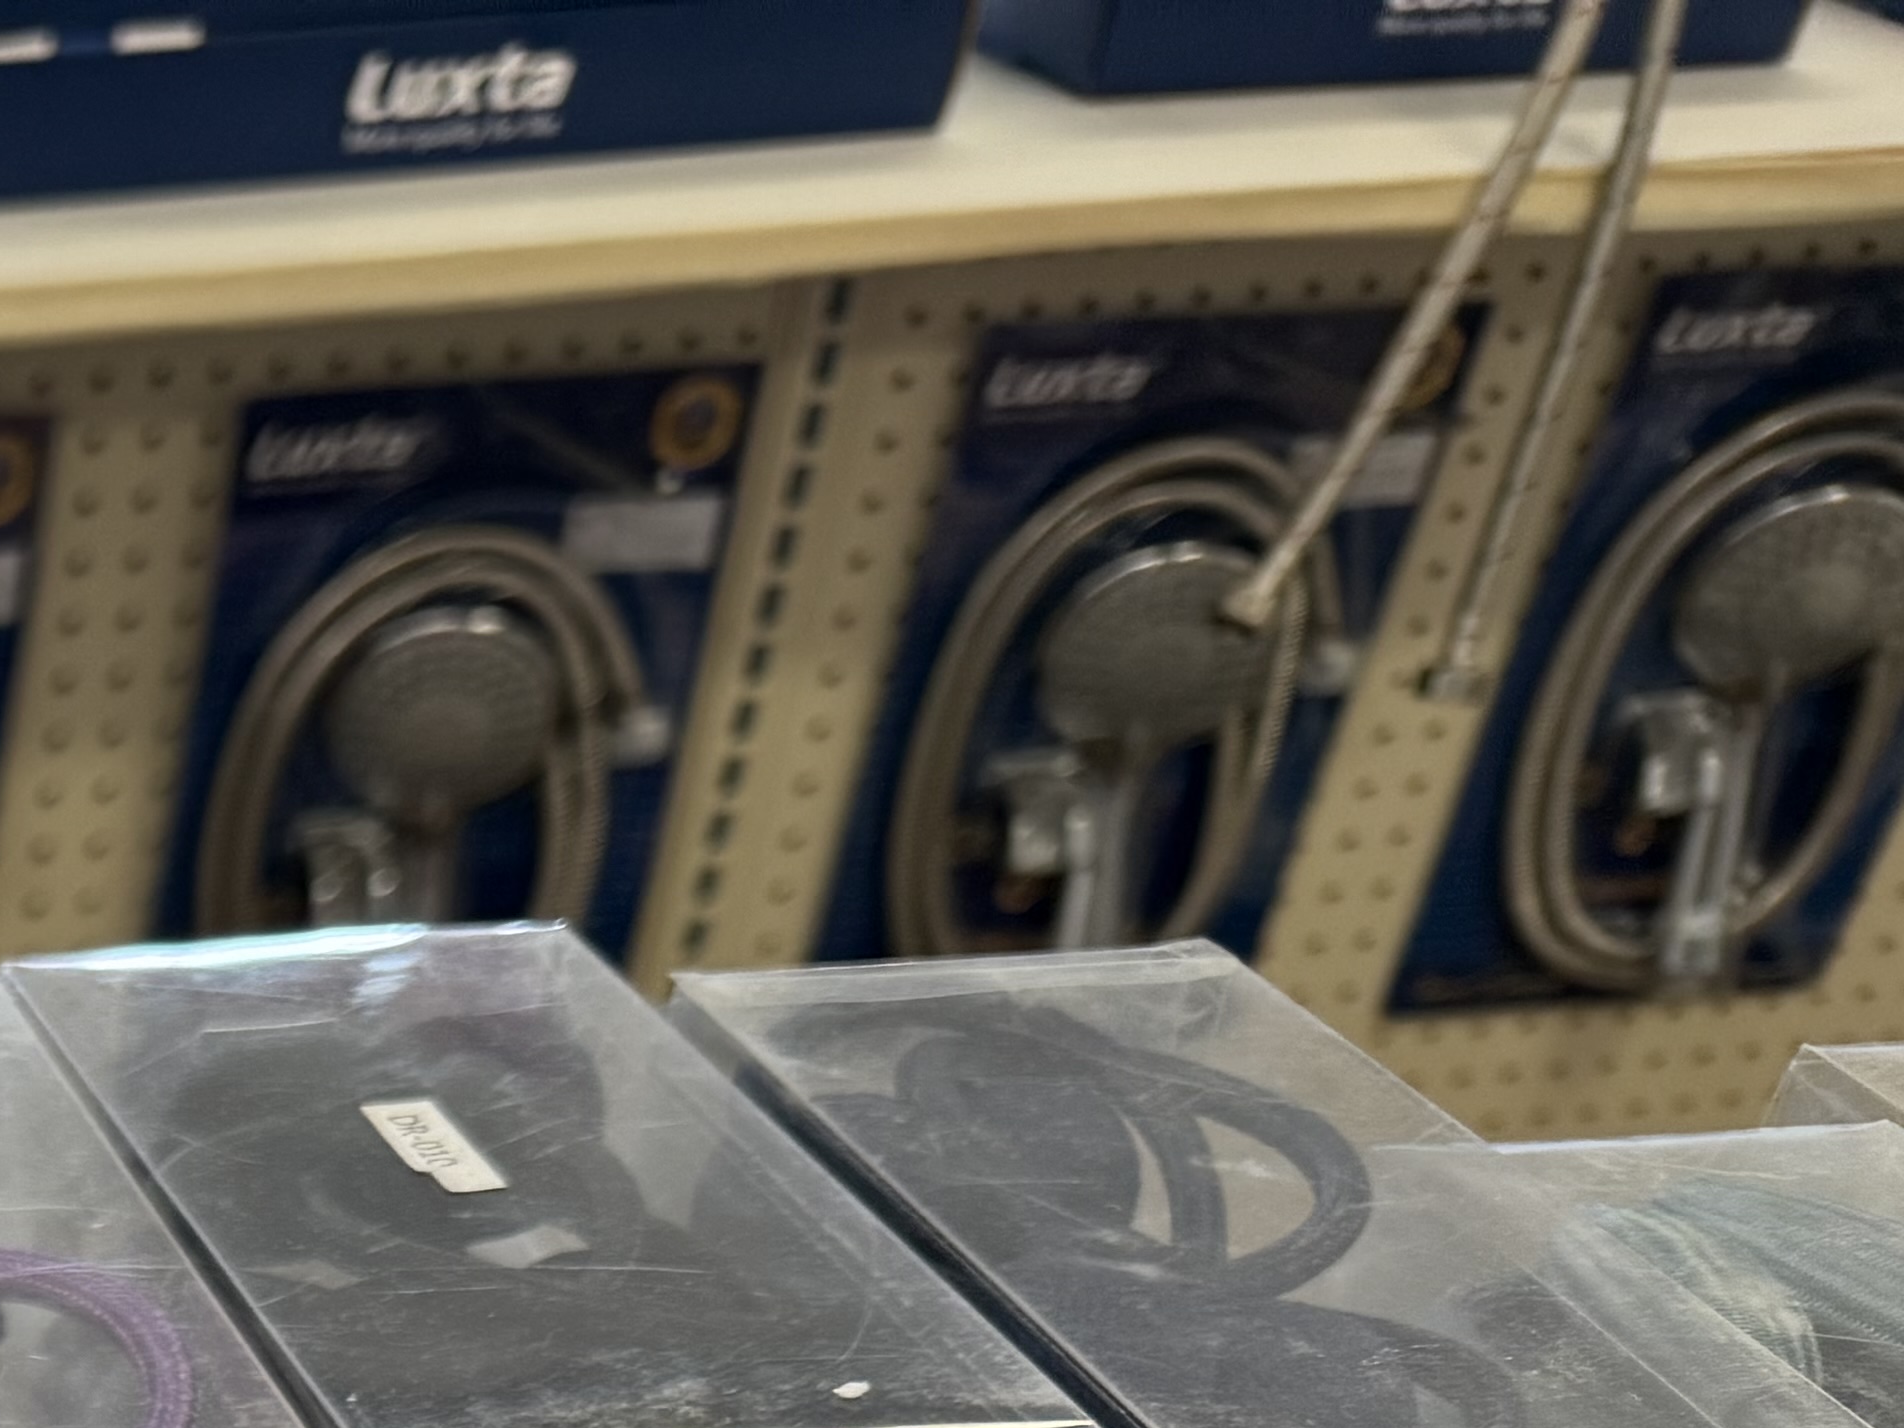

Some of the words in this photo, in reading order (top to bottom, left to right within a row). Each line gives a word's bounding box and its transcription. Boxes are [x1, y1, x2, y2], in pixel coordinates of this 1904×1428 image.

[345, 43, 577, 123] Luxta
[1655, 303, 1818, 355] Luxta
[985, 354, 1153, 402] Luxta
